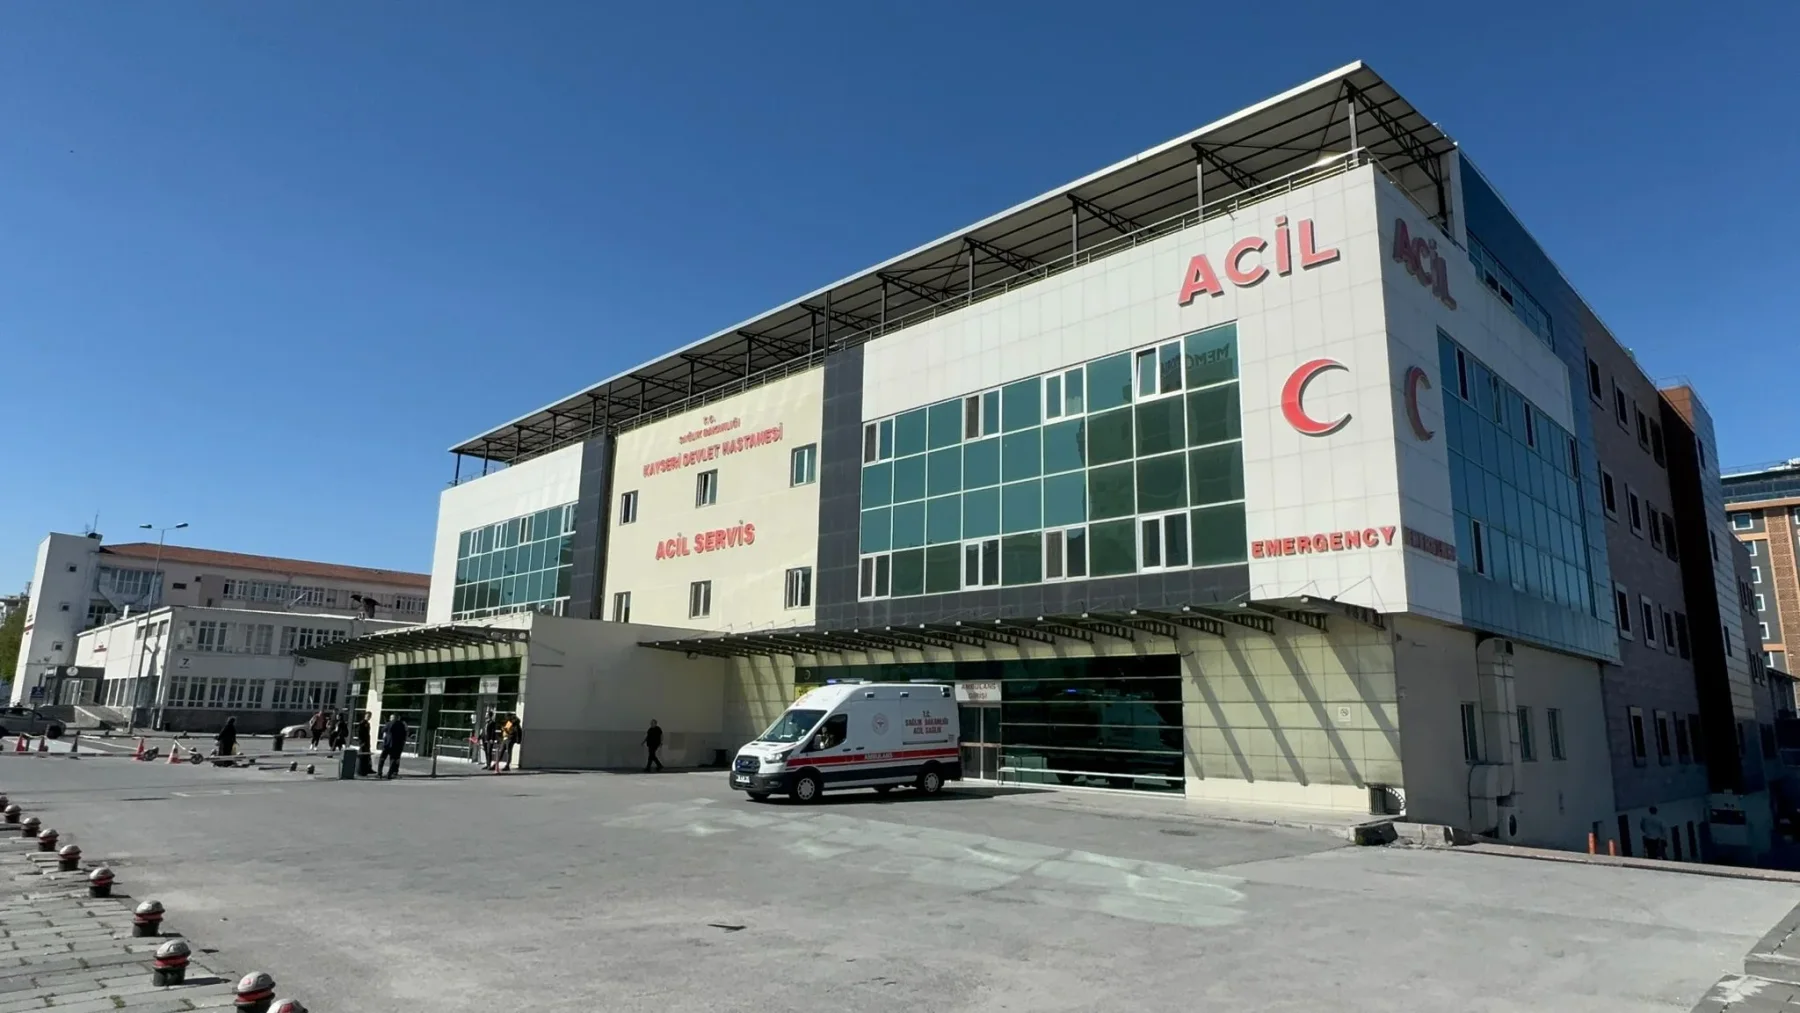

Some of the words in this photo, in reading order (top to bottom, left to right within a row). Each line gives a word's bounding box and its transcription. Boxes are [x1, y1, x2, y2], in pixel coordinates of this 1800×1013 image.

[1178, 215, 1341, 307] ACİL
[1392, 218, 1457, 311] ACİL
[643, 453, 682, 477] KAYSERİ
[683, 445, 721, 467] DEVLET
[722, 422, 783, 456] HASTANESİ
[655, 532, 690, 560] ACİL
[694, 519, 755, 554] SERVİS
[1251, 526, 1396, 559] EMERGENCY
